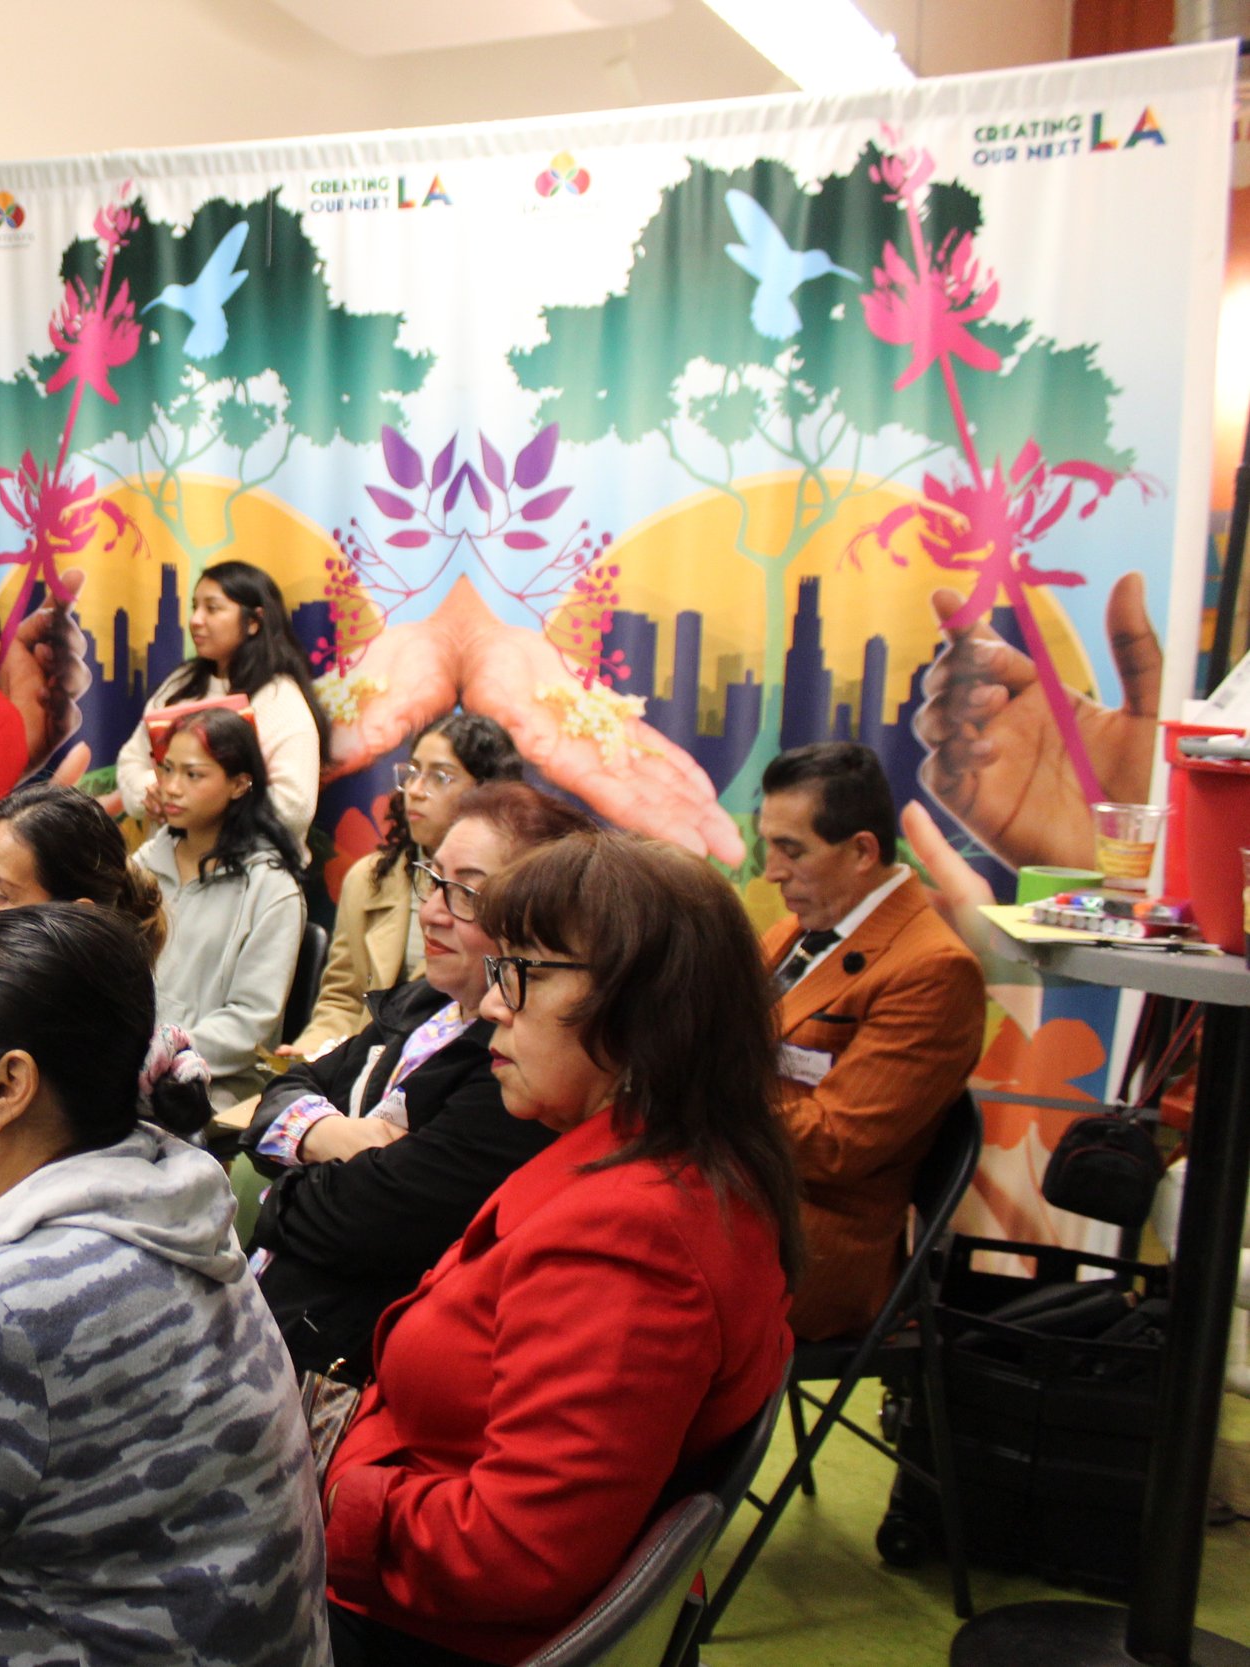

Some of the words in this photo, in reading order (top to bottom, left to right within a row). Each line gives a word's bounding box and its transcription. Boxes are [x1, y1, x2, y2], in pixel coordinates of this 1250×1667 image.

[974, 115, 1082, 143] CREATING
[1090, 104, 1166, 152] LA
[973, 147, 1017, 166] OUR
[1027, 138, 1082, 161] NEXT
[310, 176, 390, 194] CREATING
[398, 173, 453, 209] LA
[310, 196, 344, 213] OUR
[349, 195, 390, 211] NEXT
